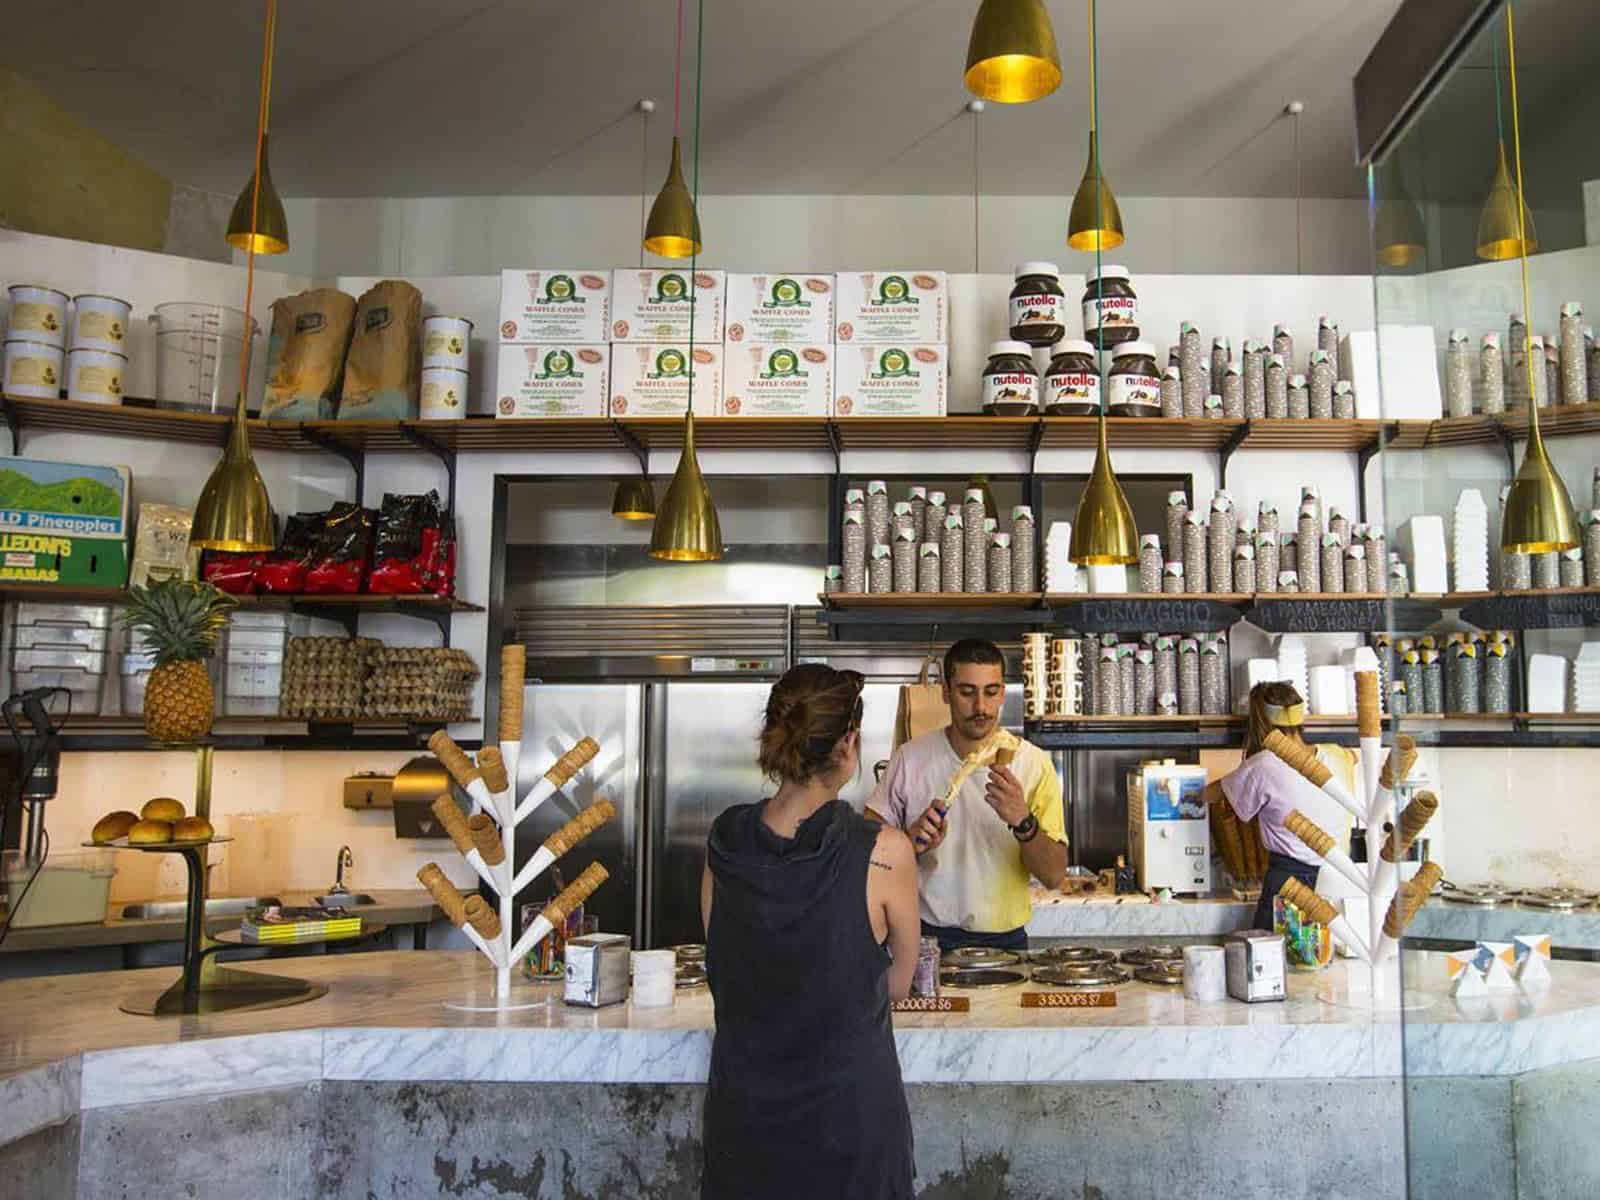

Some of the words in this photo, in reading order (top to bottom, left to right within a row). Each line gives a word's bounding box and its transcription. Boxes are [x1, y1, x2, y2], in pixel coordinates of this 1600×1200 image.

[1017, 292, 1056, 307] nutella
[993, 371, 1032, 385] nutella
[1051, 371, 1096, 387] nutella
[1125, 375, 1161, 387] nutella
[27, 513, 116, 534] Pineapples
[1081, 601, 1211, 625] FORMAGGIO
